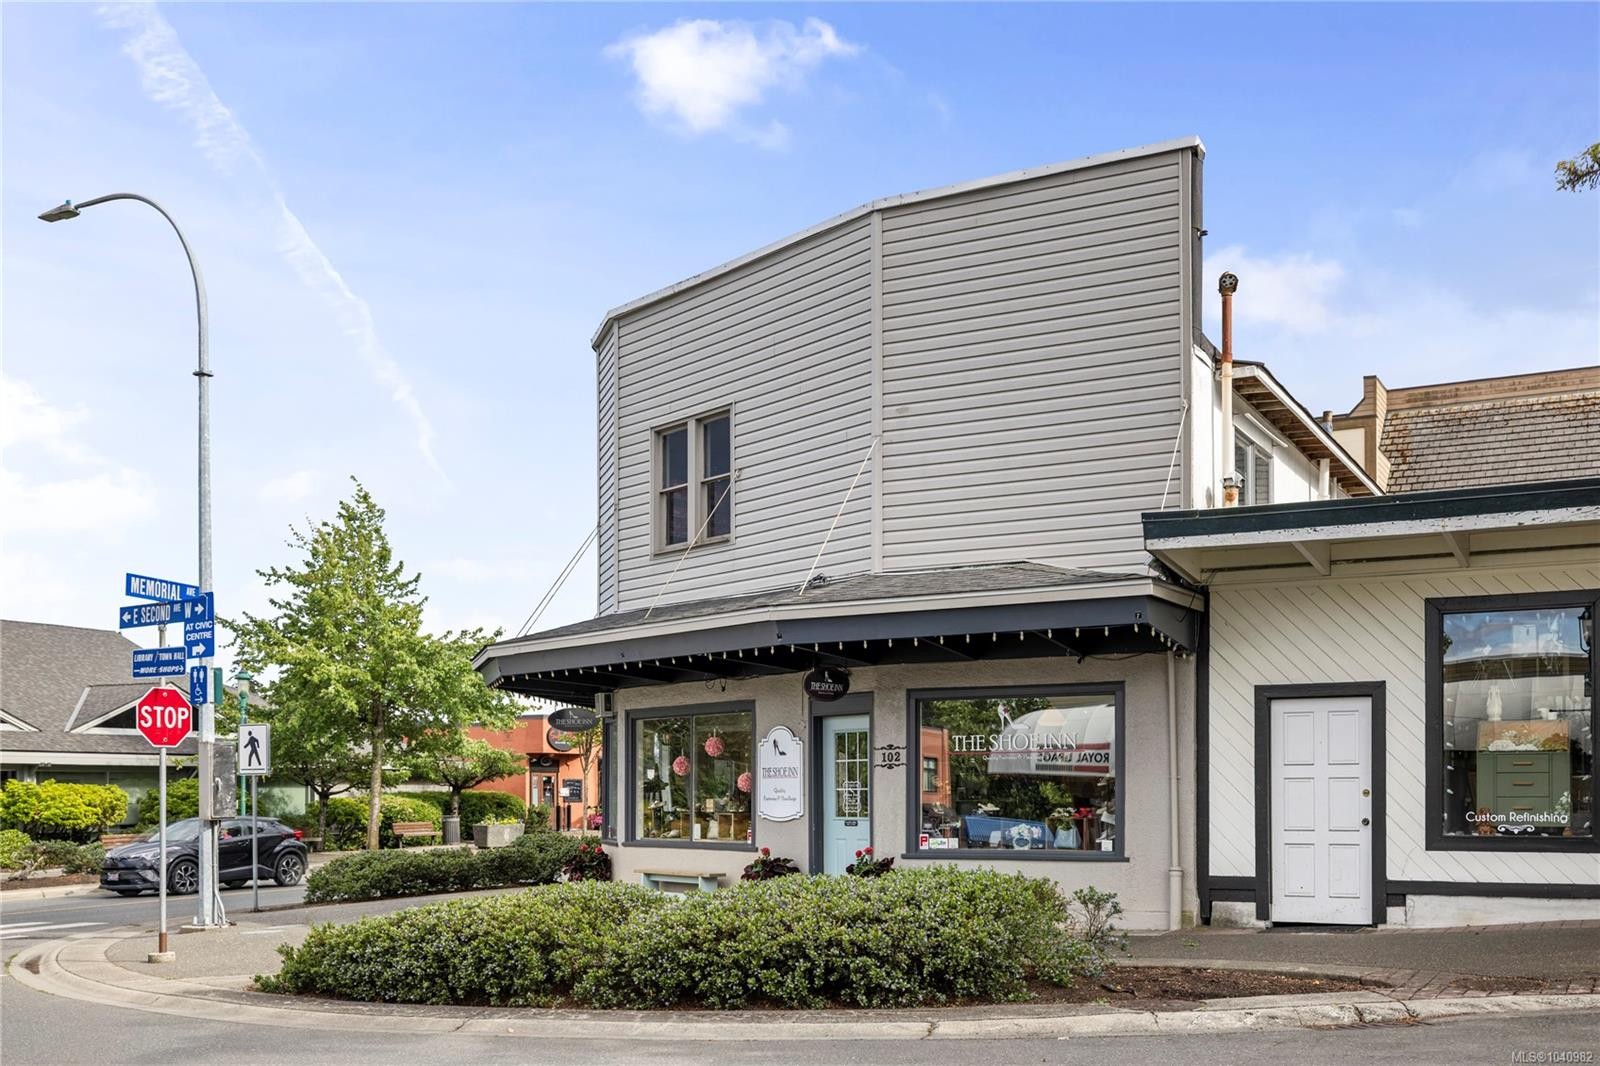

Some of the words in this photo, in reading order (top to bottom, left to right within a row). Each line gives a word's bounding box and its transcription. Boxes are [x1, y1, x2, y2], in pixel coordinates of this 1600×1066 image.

[130, 577, 182, 601] MEMORIAL
[186, 588, 196, 597] AVE
[133, 609, 138, 624] E
[141, 604, 171, 623] SECOND
[184, 602, 192, 619] W
[185, 623, 194, 631] AT
[195, 621, 212, 631] CIVIC
[186, 631, 212, 641] CENTRE
[140, 705, 189, 729] STOP
[952, 734, 986, 752] THE
[989, 733, 1040, 751] SHOE
[1040, 733, 1078, 750] INN
[881, 751, 901, 762] 102
[1465, 811, 1506, 822] Custom
[1509, 811, 1568, 824] Refinishing
